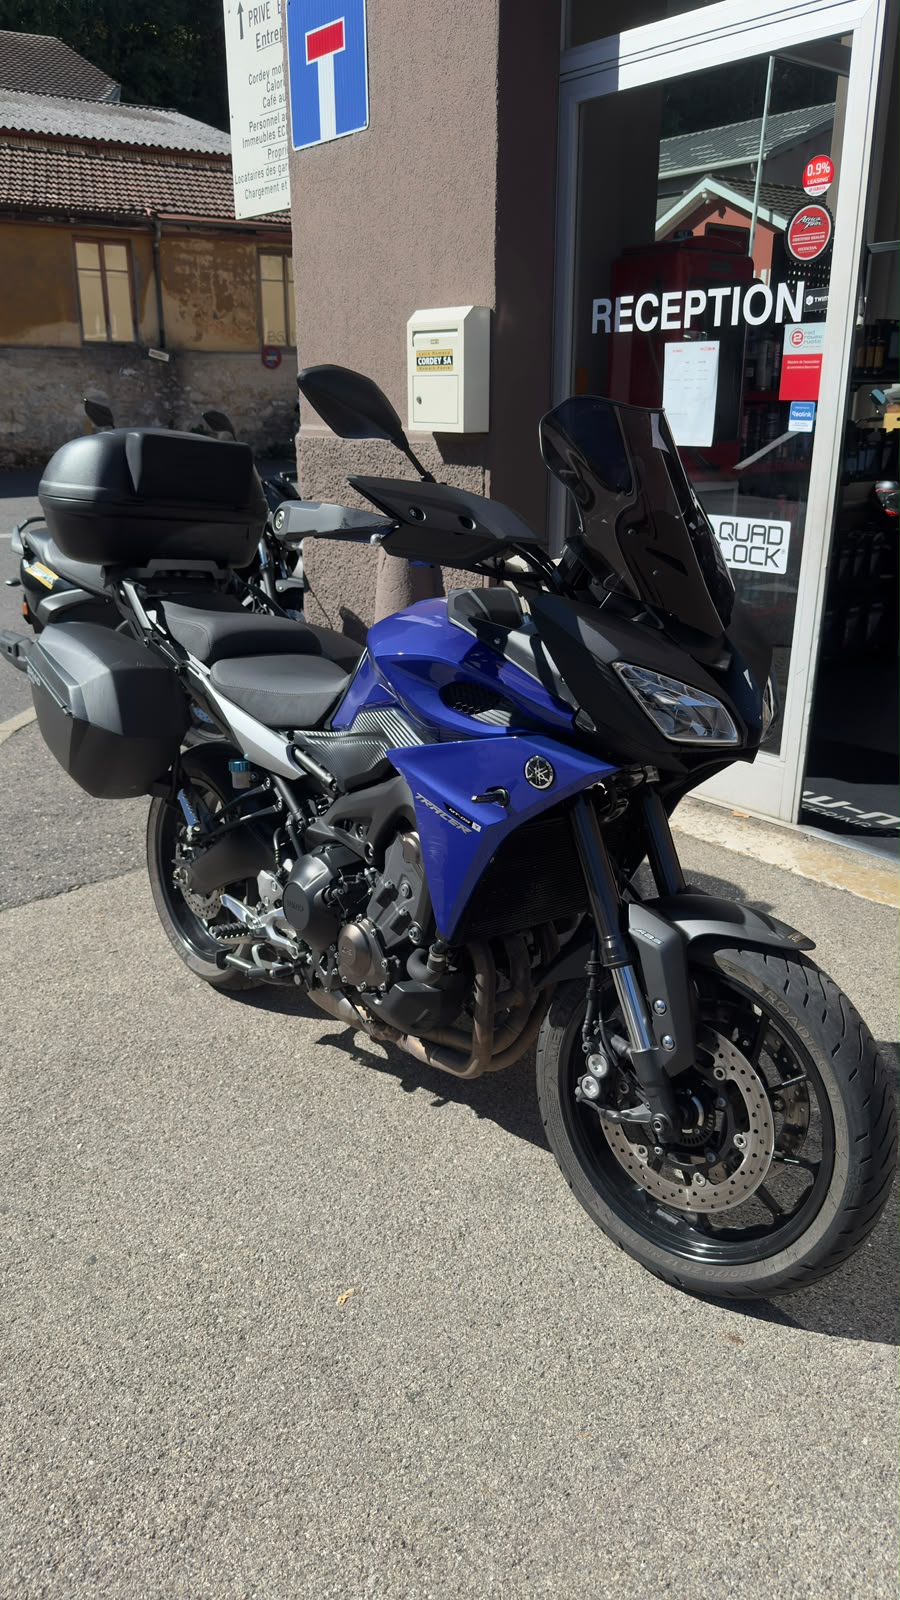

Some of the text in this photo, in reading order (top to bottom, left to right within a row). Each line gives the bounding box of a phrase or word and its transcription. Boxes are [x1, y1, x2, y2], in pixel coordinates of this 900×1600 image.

[248, 69, 270, 86] Cordey
[262, 92, 277, 109] Café
[249, 112, 280, 133] Personnel
[242, 131, 276, 149] Immeubles
[234, 168, 264, 185] Locataires
[265, 164, 276, 177] des
[806, 161, 831, 177] 0.9%
[244, 180, 288, 200] Chargement et
[591, 280, 805, 334] RECEPTION
[418, 356, 452, 365] CORDEY SA
[719, 521, 784, 546] QUAD
[725, 544, 782, 568] OCK
[415, 792, 472, 835] TRACER
[635, 929, 664, 945] ABS
